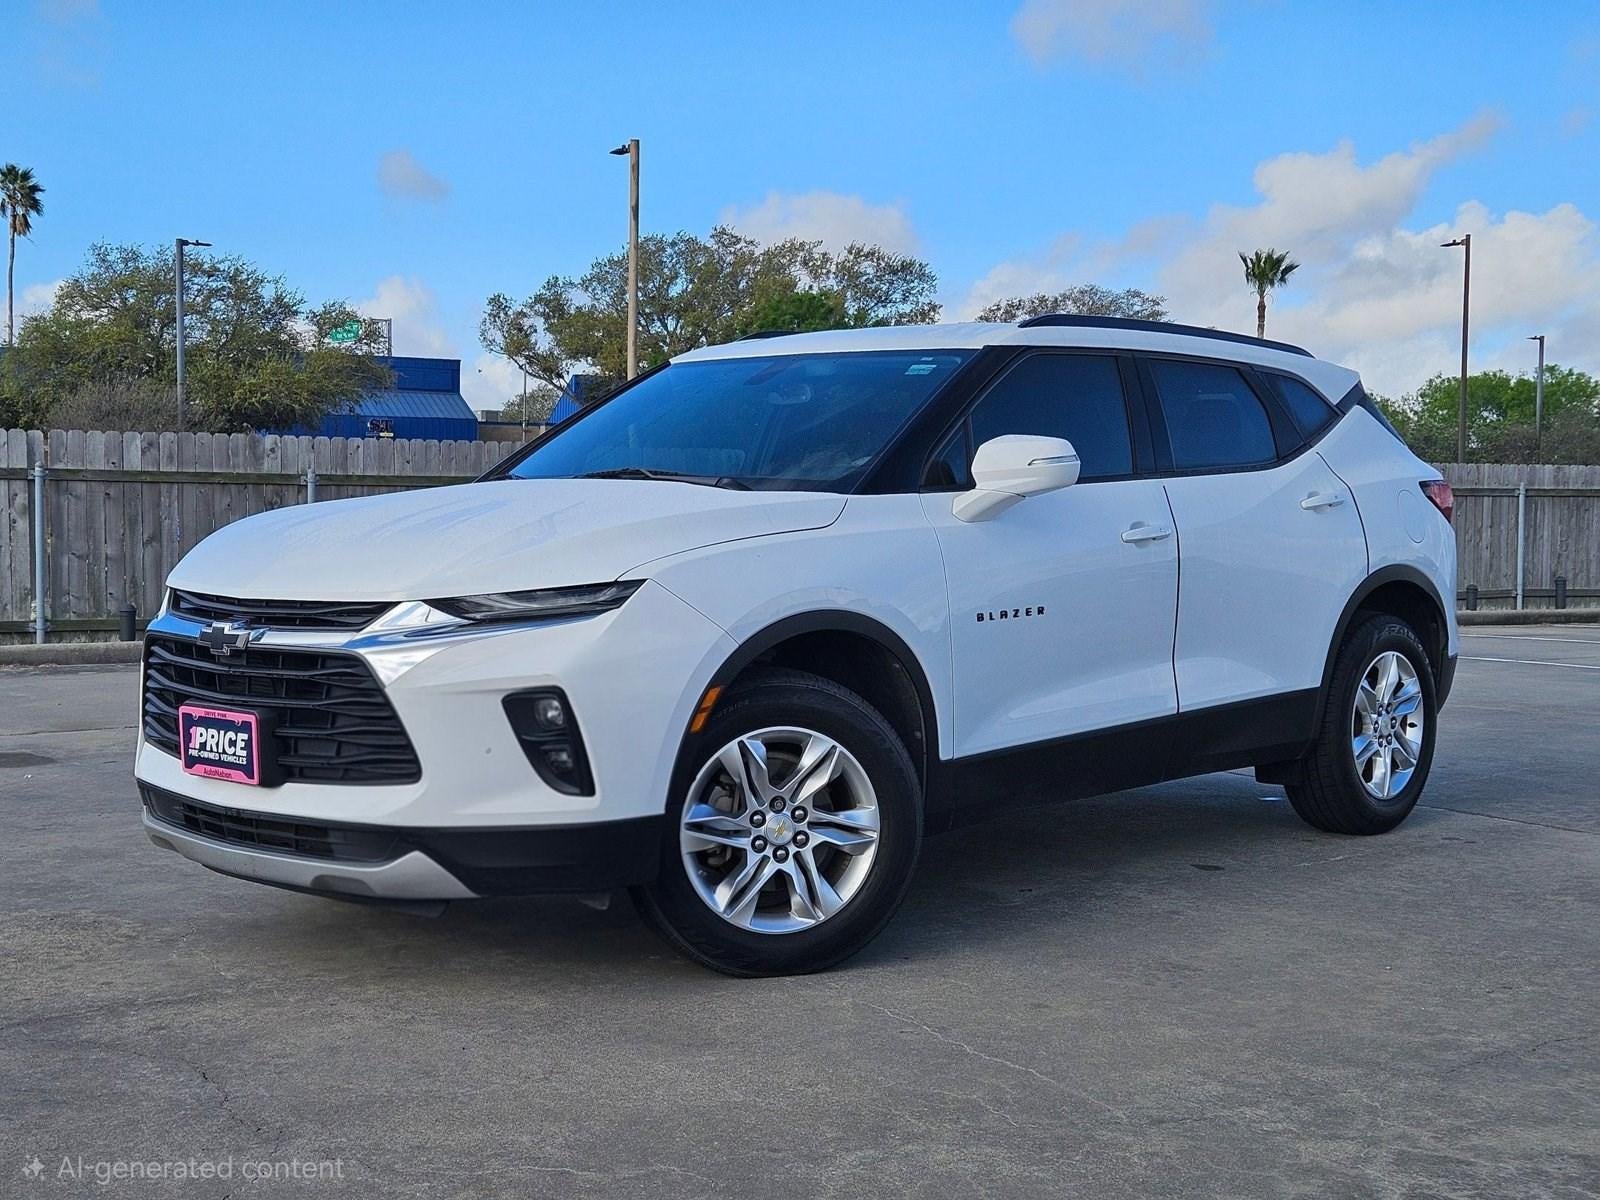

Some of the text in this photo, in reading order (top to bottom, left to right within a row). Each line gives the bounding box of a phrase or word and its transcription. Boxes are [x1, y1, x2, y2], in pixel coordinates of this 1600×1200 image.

[976, 606, 1045, 622] BLAZER
[188, 748, 247, 765] PRE-OWNED VEHICLES
[203, 767, 233, 779] AutoNation
